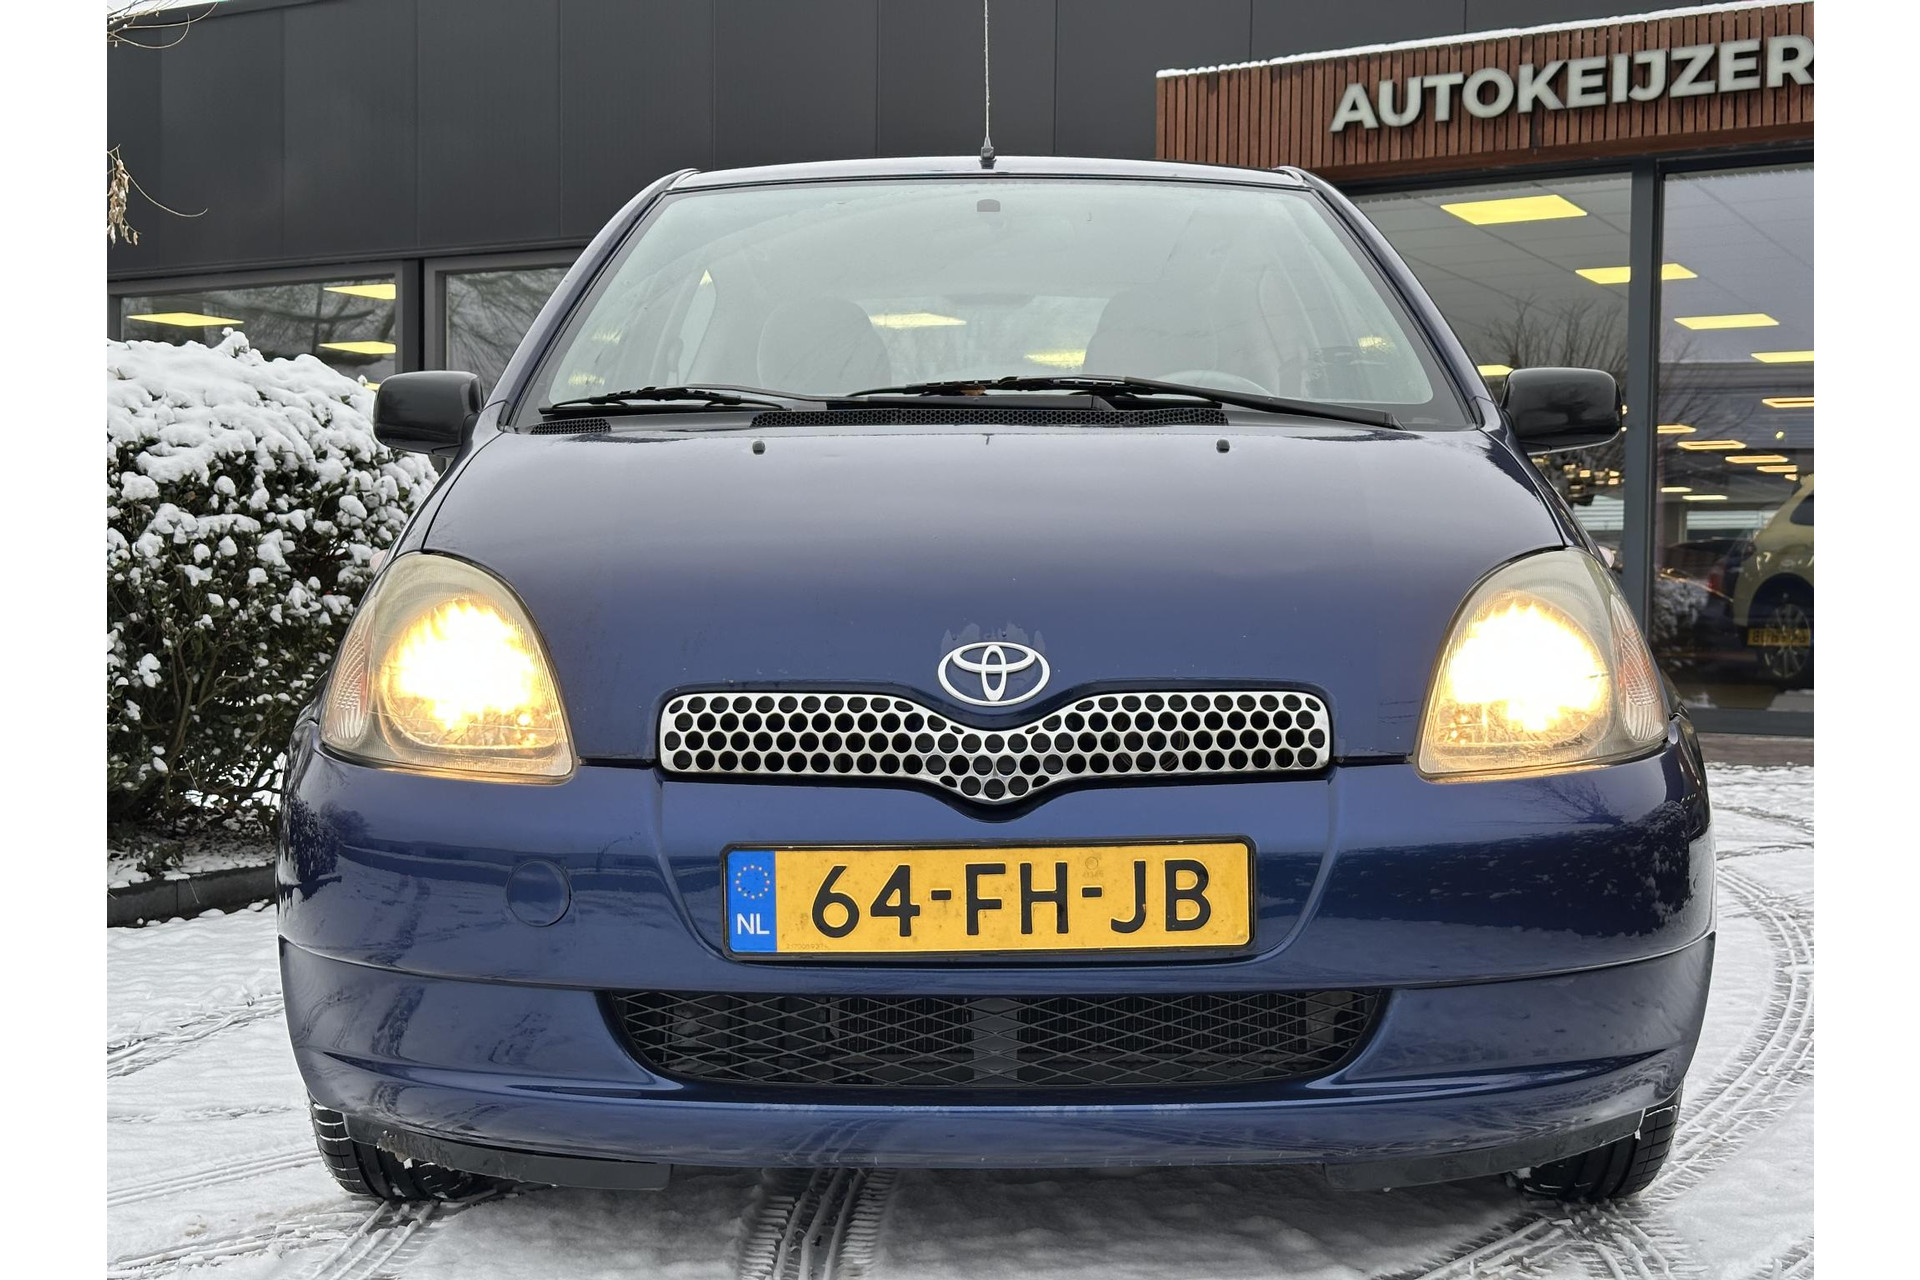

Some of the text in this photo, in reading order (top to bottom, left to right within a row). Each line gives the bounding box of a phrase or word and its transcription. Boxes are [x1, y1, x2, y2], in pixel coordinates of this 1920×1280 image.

[1330, 35, 1814, 132] AUTOKEIJZER
[736, 912, 771, 935] NL
[811, 859, 1212, 938] 64-FH-JB
